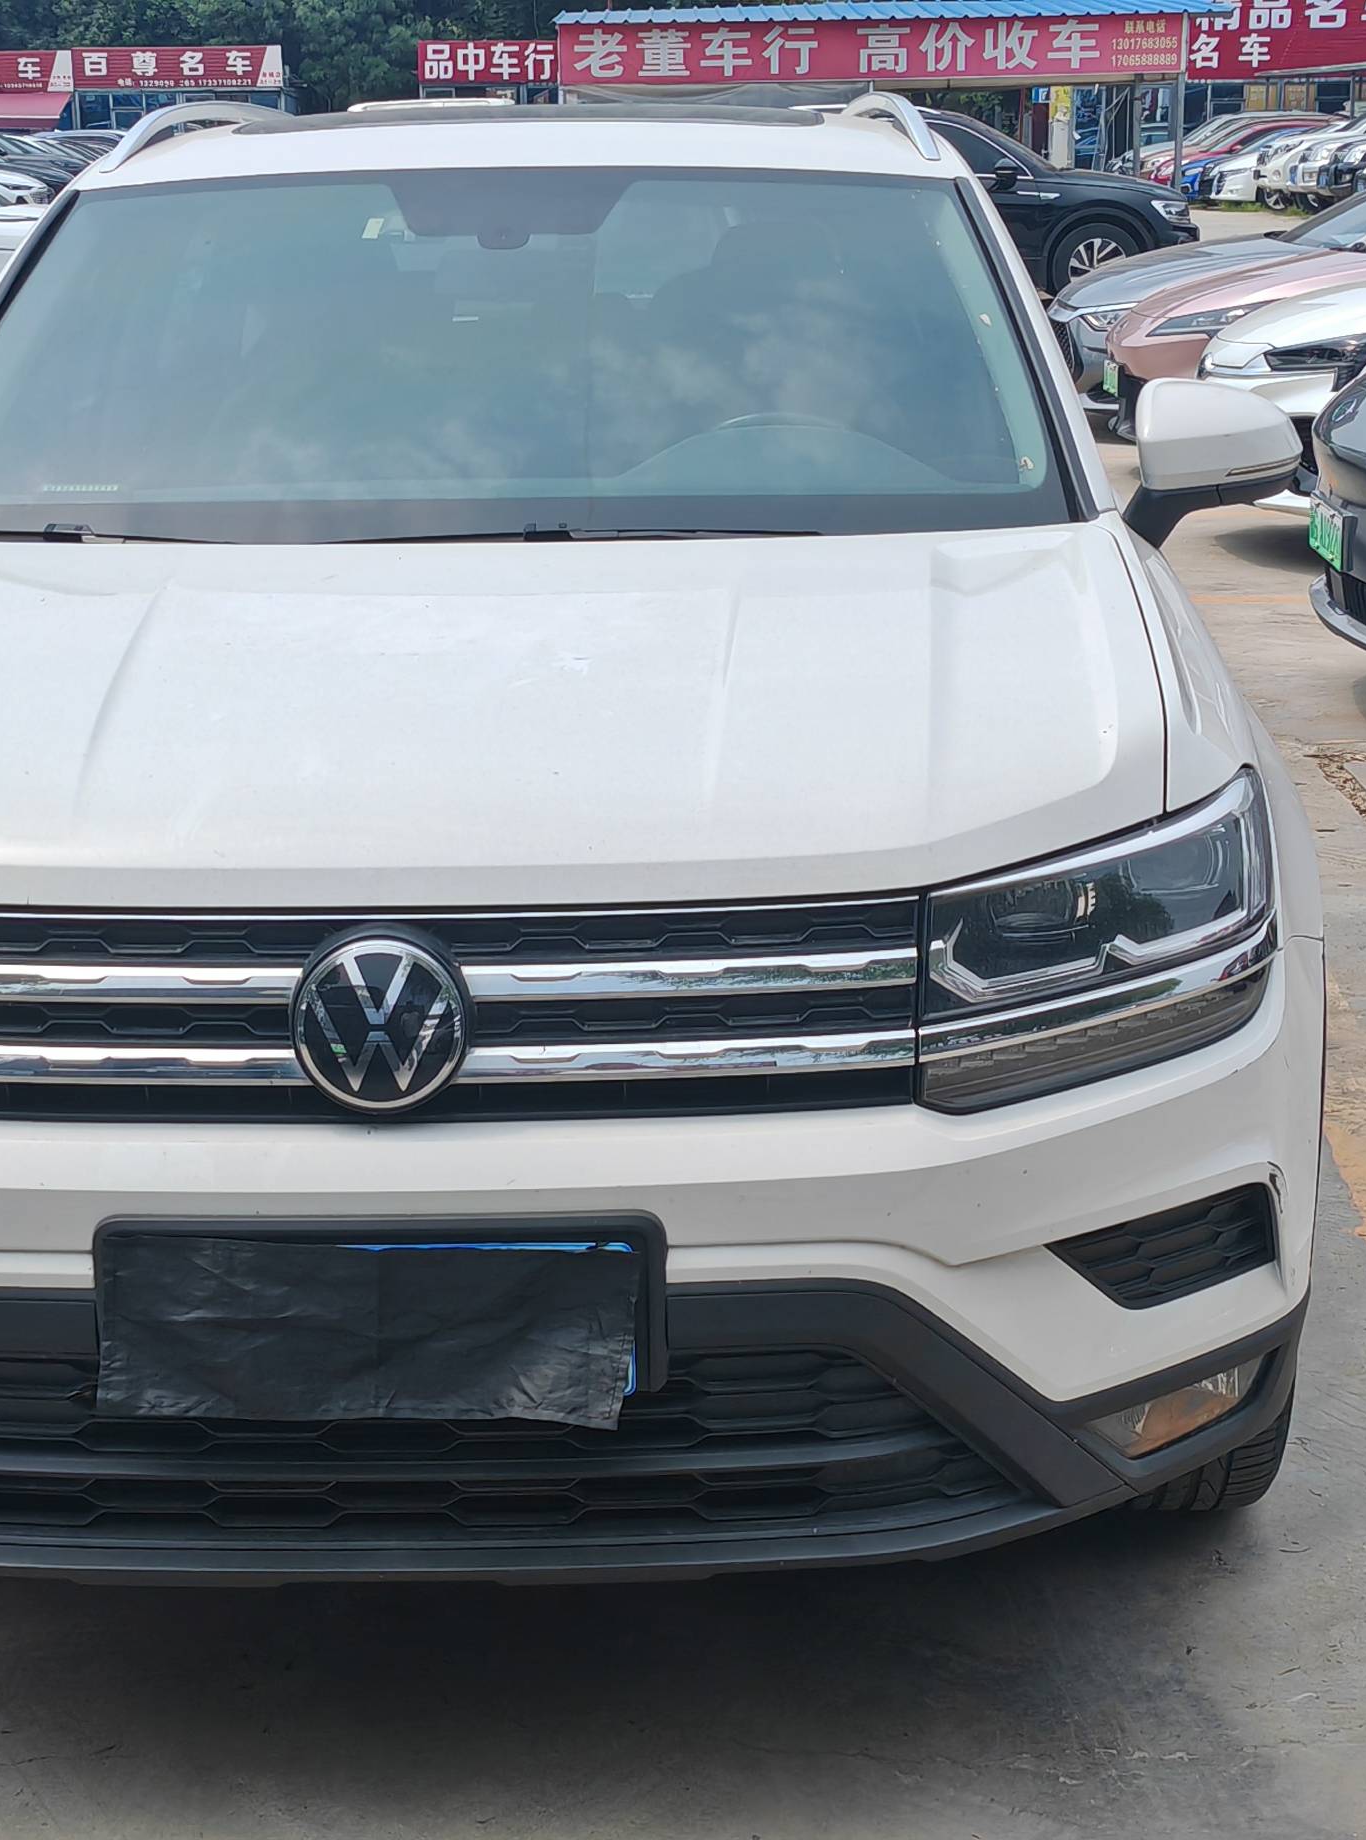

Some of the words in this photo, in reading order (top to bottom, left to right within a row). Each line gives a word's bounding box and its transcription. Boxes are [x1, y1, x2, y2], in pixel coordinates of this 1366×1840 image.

[82, 51, 253, 77] 百尊名车
[424, 42, 555, 81] 品中车行
[573, 25, 818, 78] 老董车行
[856, 19, 1101, 73] 高价收车
[1189, 33, 1271, 68] 名车
